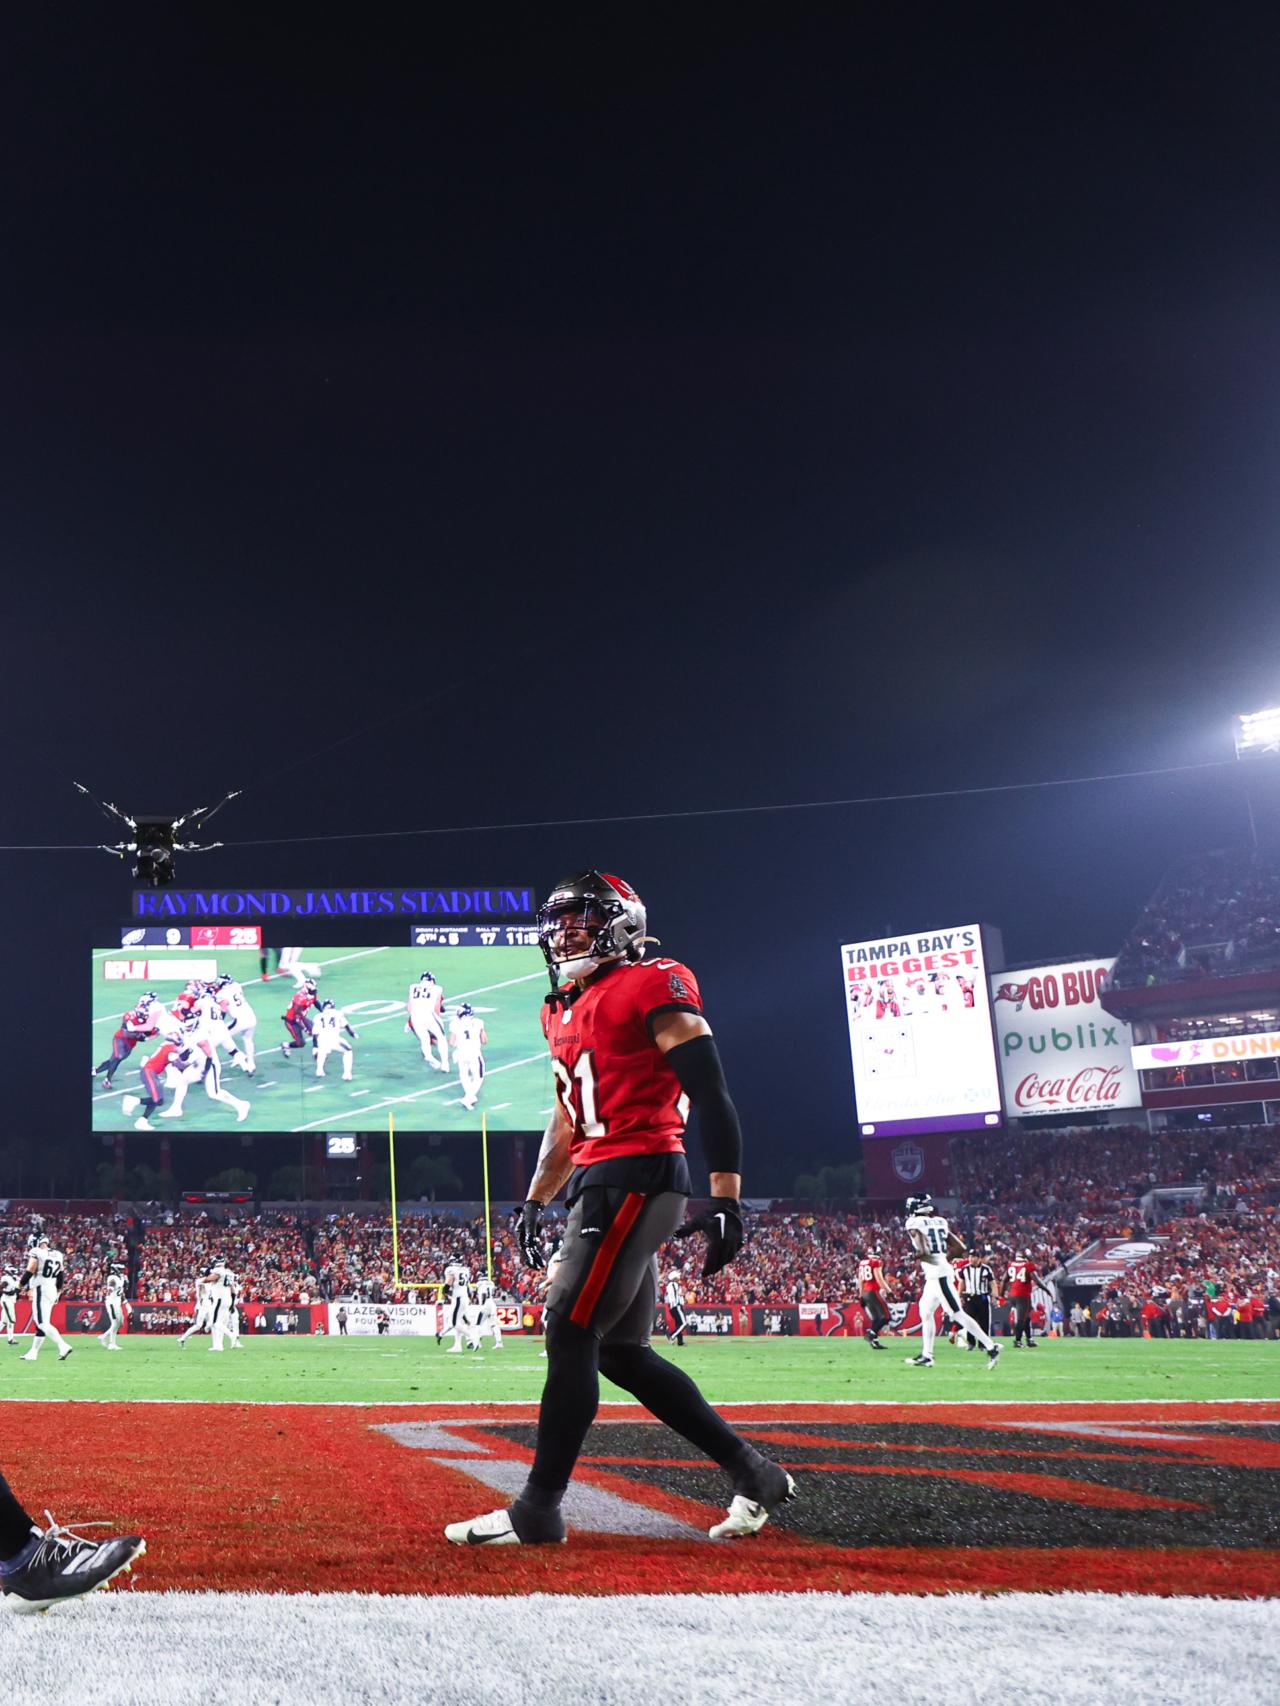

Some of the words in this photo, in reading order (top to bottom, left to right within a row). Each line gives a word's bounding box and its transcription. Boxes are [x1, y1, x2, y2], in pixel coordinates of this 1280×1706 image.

[137, 892, 290, 916] RAYMOND
[295, 891, 394, 916] JAMES
[402, 889, 531, 914] STADIUM
[166, 928, 181, 944] 9
[229, 928, 257, 944] 25
[480, 933, 496, 945] 17
[506, 933, 539, 945] 11:5
[846, 941, 911, 964] TAMPA
[917, 931, 974, 953] BAY'S
[848, 949, 976, 981] BIGGEST
[1028, 975, 1059, 1010] GO
[1062, 967, 1107, 1006] BUC
[320, 1017, 336, 1029] 14
[1003, 1022, 1119, 1056] Publix
[1212, 1037, 1280, 1058] DUNK
[329, 1137, 355, 1153] 25
[928, 1228, 947, 1253] 16
[42, 1259, 61, 1278] 62
[1008, 1267, 1026, 1282] 94
[345, 1307, 381, 1316] LAZE
[388, 1307, 426, 1316] VISION
[496, 1308, 518, 1325] 25
